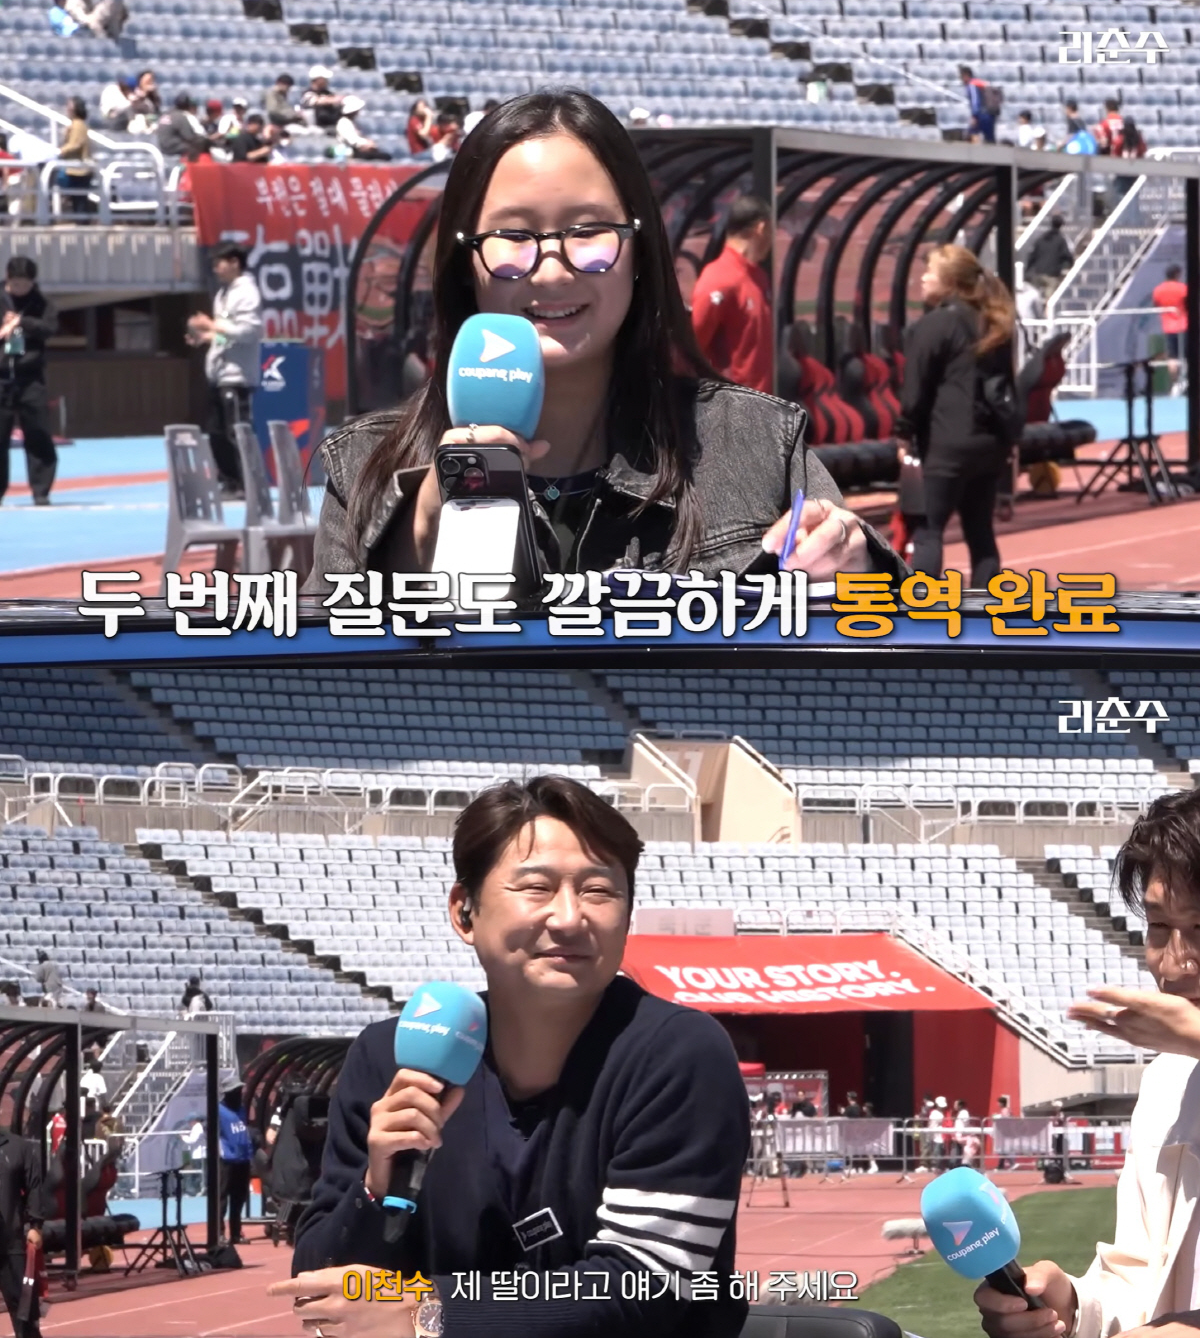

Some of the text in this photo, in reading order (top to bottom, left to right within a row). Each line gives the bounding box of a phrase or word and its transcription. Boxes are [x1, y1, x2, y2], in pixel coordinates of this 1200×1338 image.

[508, 367, 534, 384] play
[654, 959, 902, 990] YOUR STORY.
[947, 1227, 1000, 1261] coupang play
